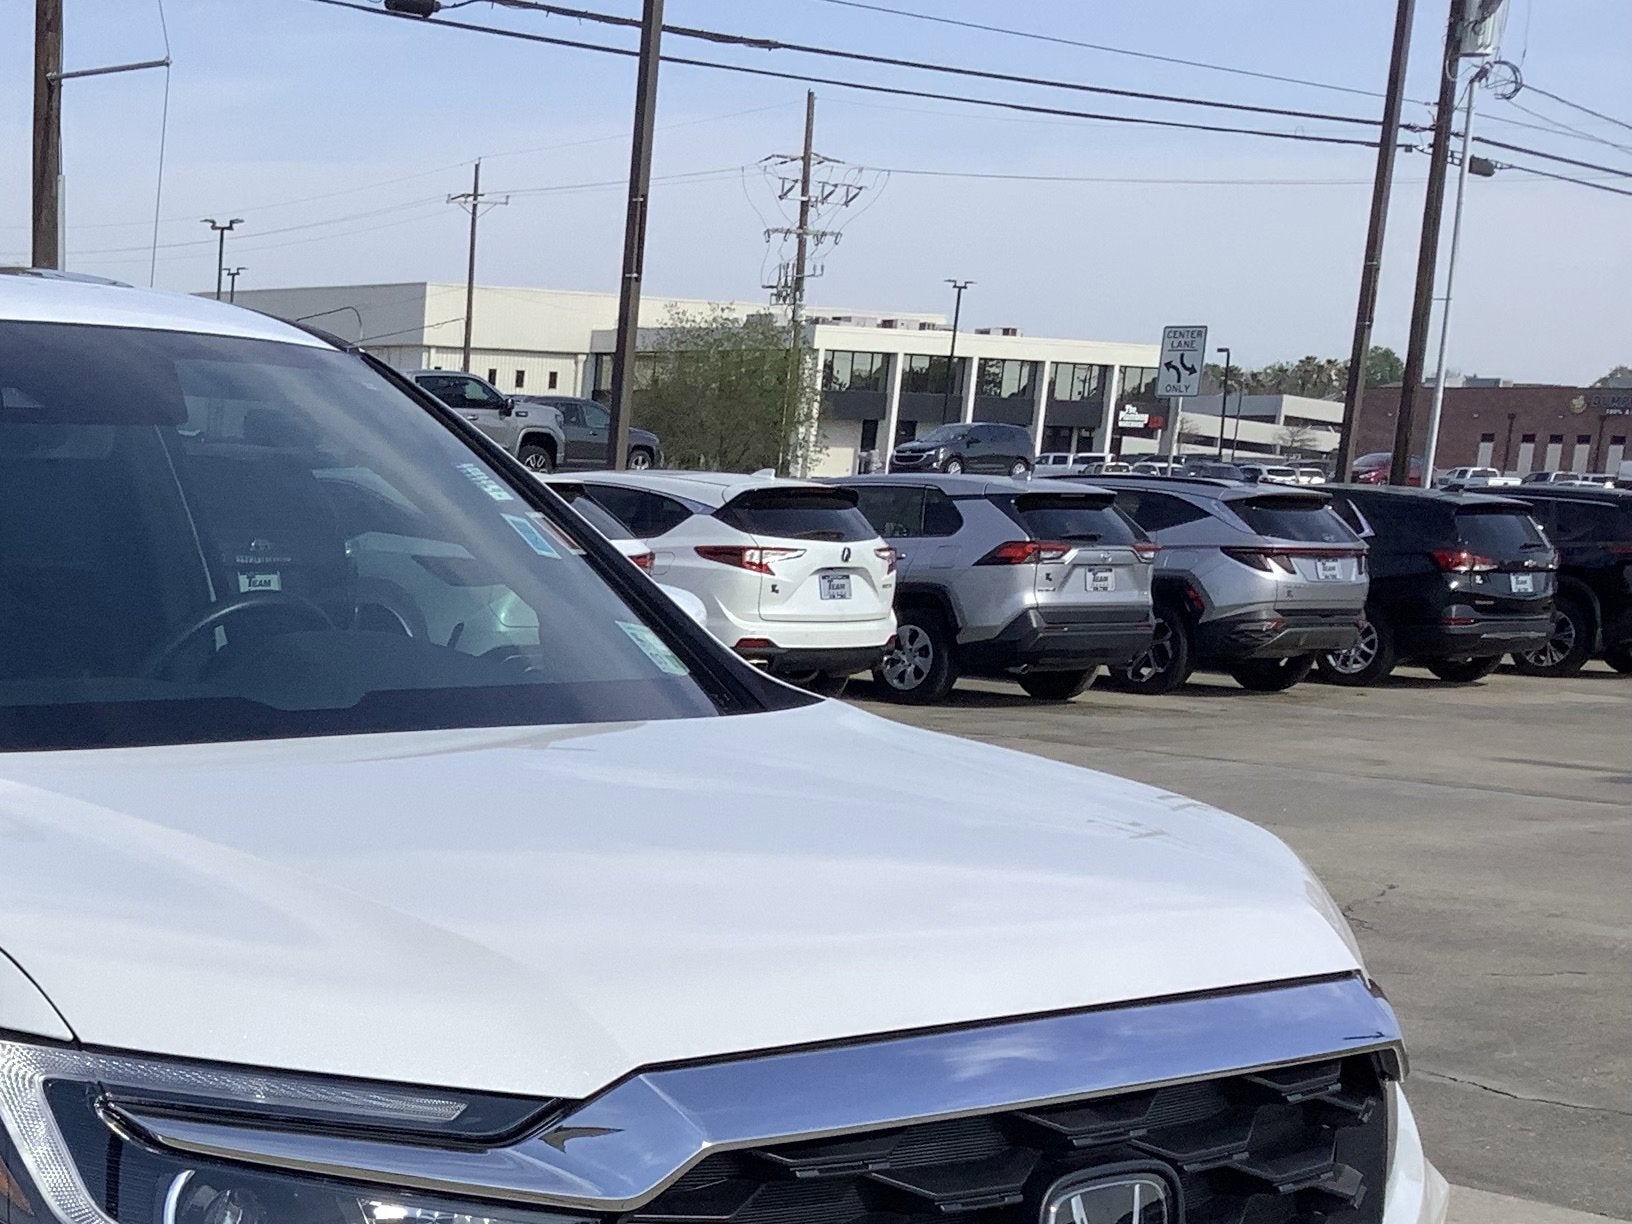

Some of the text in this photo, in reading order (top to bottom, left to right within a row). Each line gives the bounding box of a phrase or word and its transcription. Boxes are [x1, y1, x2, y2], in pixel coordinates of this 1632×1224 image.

[1166, 329, 1203, 339] CENTER
[1170, 340, 1197, 349] LANE
[1165, 384, 1191, 393] ONLY
